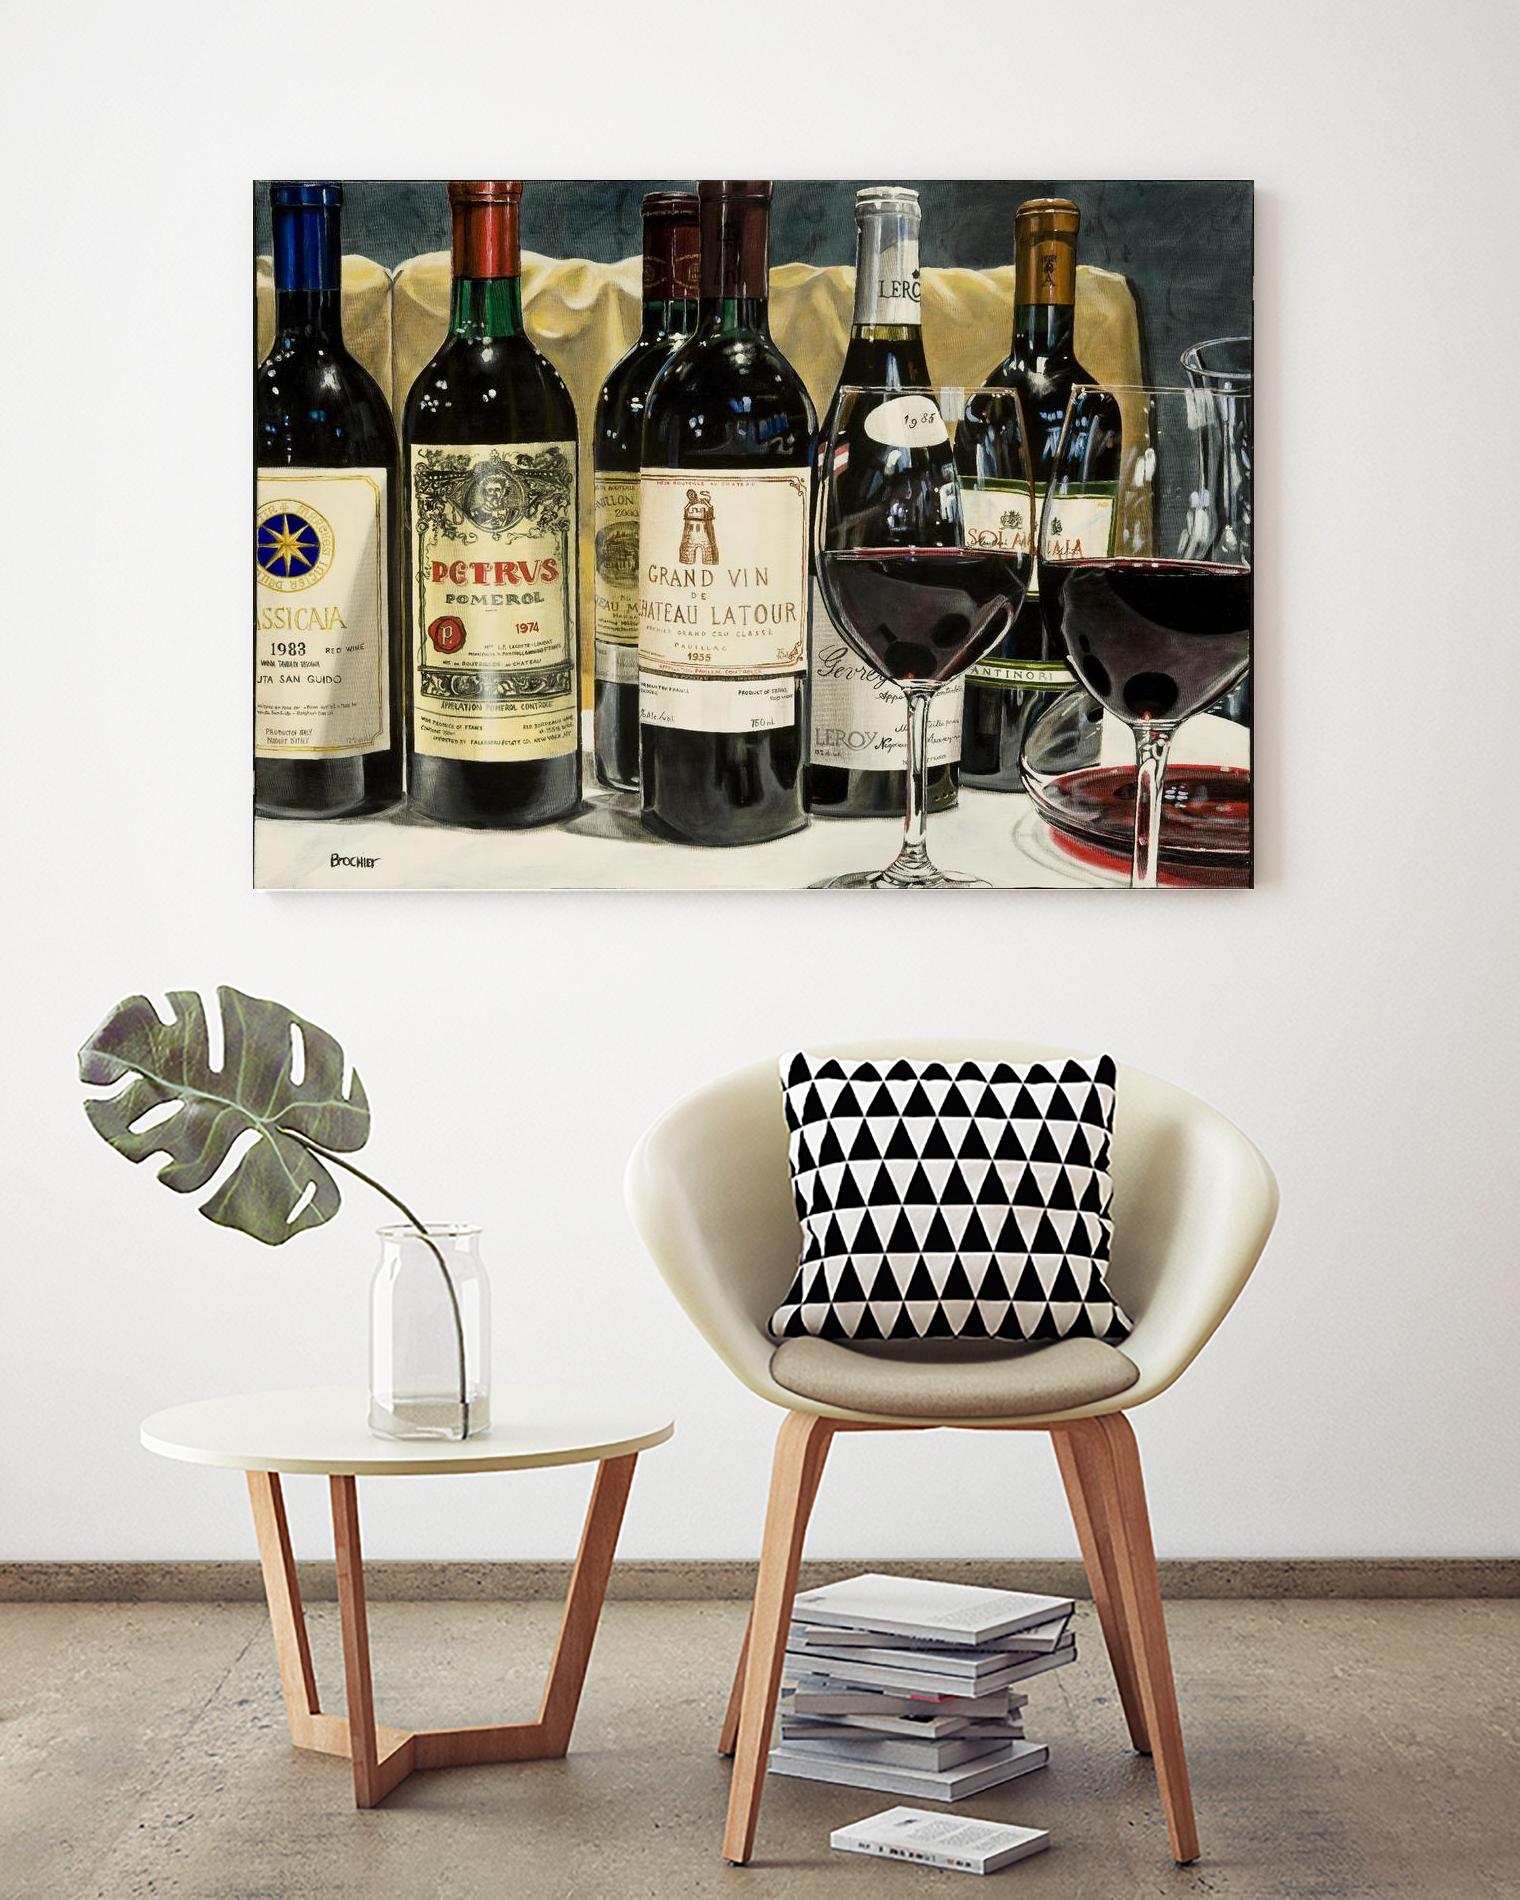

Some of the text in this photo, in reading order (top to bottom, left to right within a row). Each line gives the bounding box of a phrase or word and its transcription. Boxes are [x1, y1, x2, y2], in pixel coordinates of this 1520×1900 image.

[649, 565, 768, 588] GRAND VIN
[446, 592, 544, 605] POMEROL
[691, 592, 706, 600] DE
[711, 602, 797, 625] LATOUR
[515, 621, 540, 634] 1974
[270, 642, 306, 656] 1983
[688, 652, 712, 661] 1955
[280, 675, 301, 684] SAN
[307, 675, 342, 684] GUIDO
[971, 666, 1053, 680] ANTINORI
[814, 727, 878, 752] LEROY
